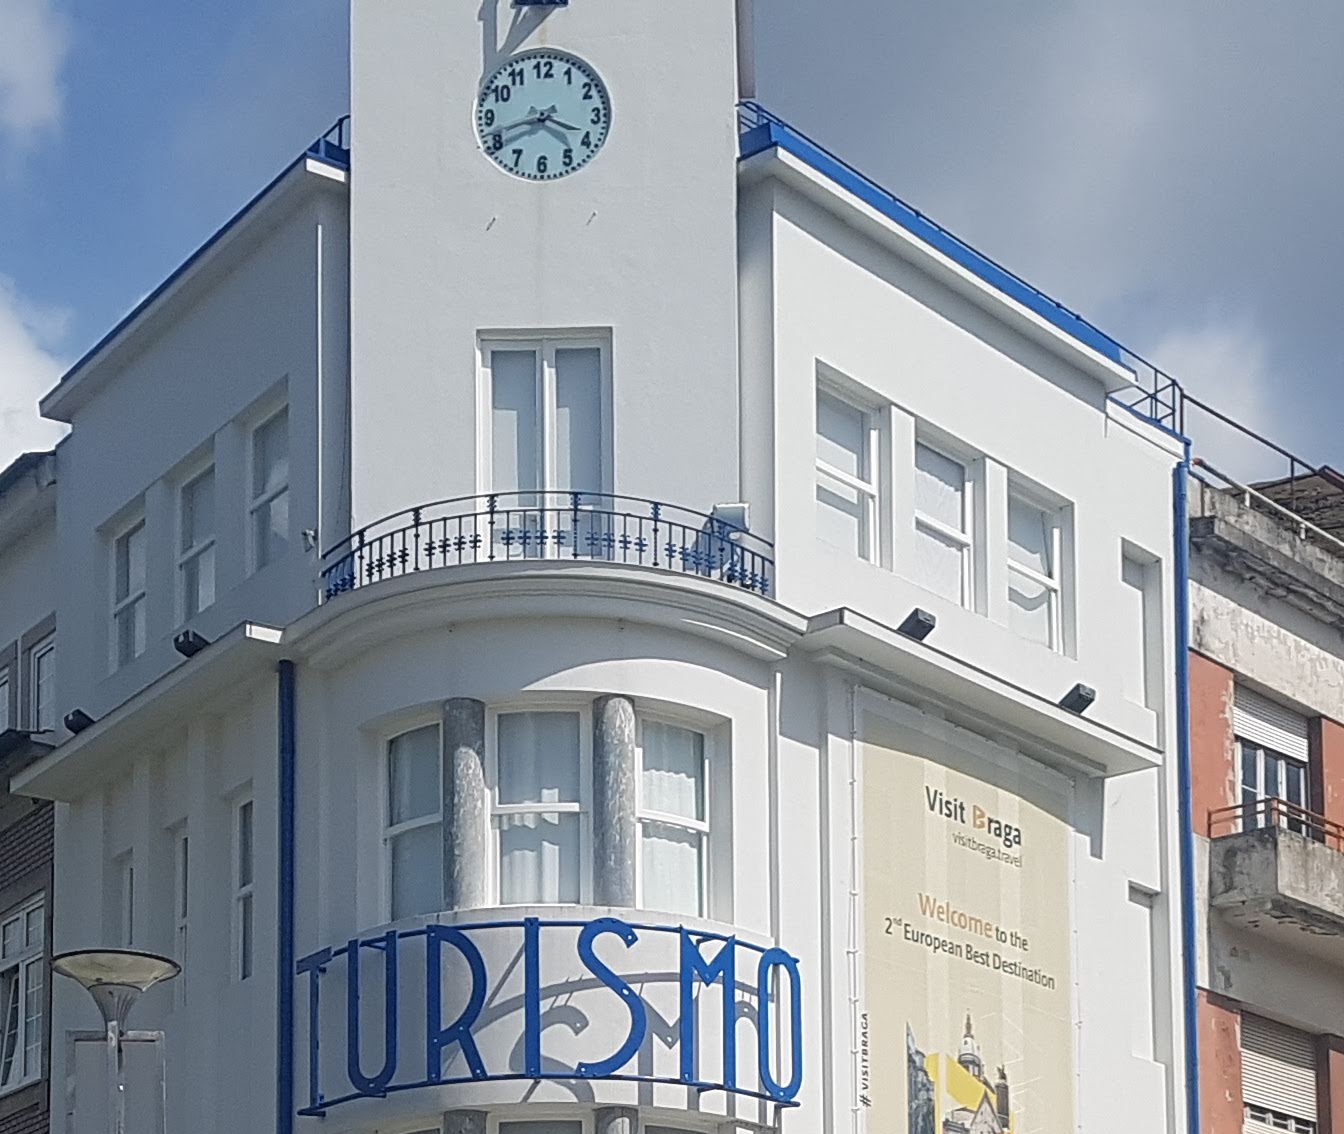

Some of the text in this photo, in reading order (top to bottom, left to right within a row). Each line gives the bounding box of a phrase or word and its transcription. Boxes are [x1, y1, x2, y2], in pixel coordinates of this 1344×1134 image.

[508, 68, 524, 86] 11
[533, 61, 554, 79] 12
[563, 67, 572, 85] 1
[492, 84, 510, 102] 10
[582, 82, 593, 100] 2
[484, 109, 495, 126] 9
[590, 107, 601, 125] 3
[492, 134, 503, 150] 8
[581, 131, 591, 149] 4
[511, 148, 523, 167] 7
[537, 155, 548, 173] 6
[562, 148, 573, 167] 5
[925, 785, 1023, 848] Visit Braga
[952, 831, 1023, 868] visitbraga.travel
[918, 892, 1029, 951] Welcome to the
[903, 922, 963, 957] European
[965, 943, 990, 968] Best
[992, 952, 1056, 990] Destination
[296, 917, 803, 1107] TURISMO
[860, 1012, 872, 1108] #VISITBRAGA
